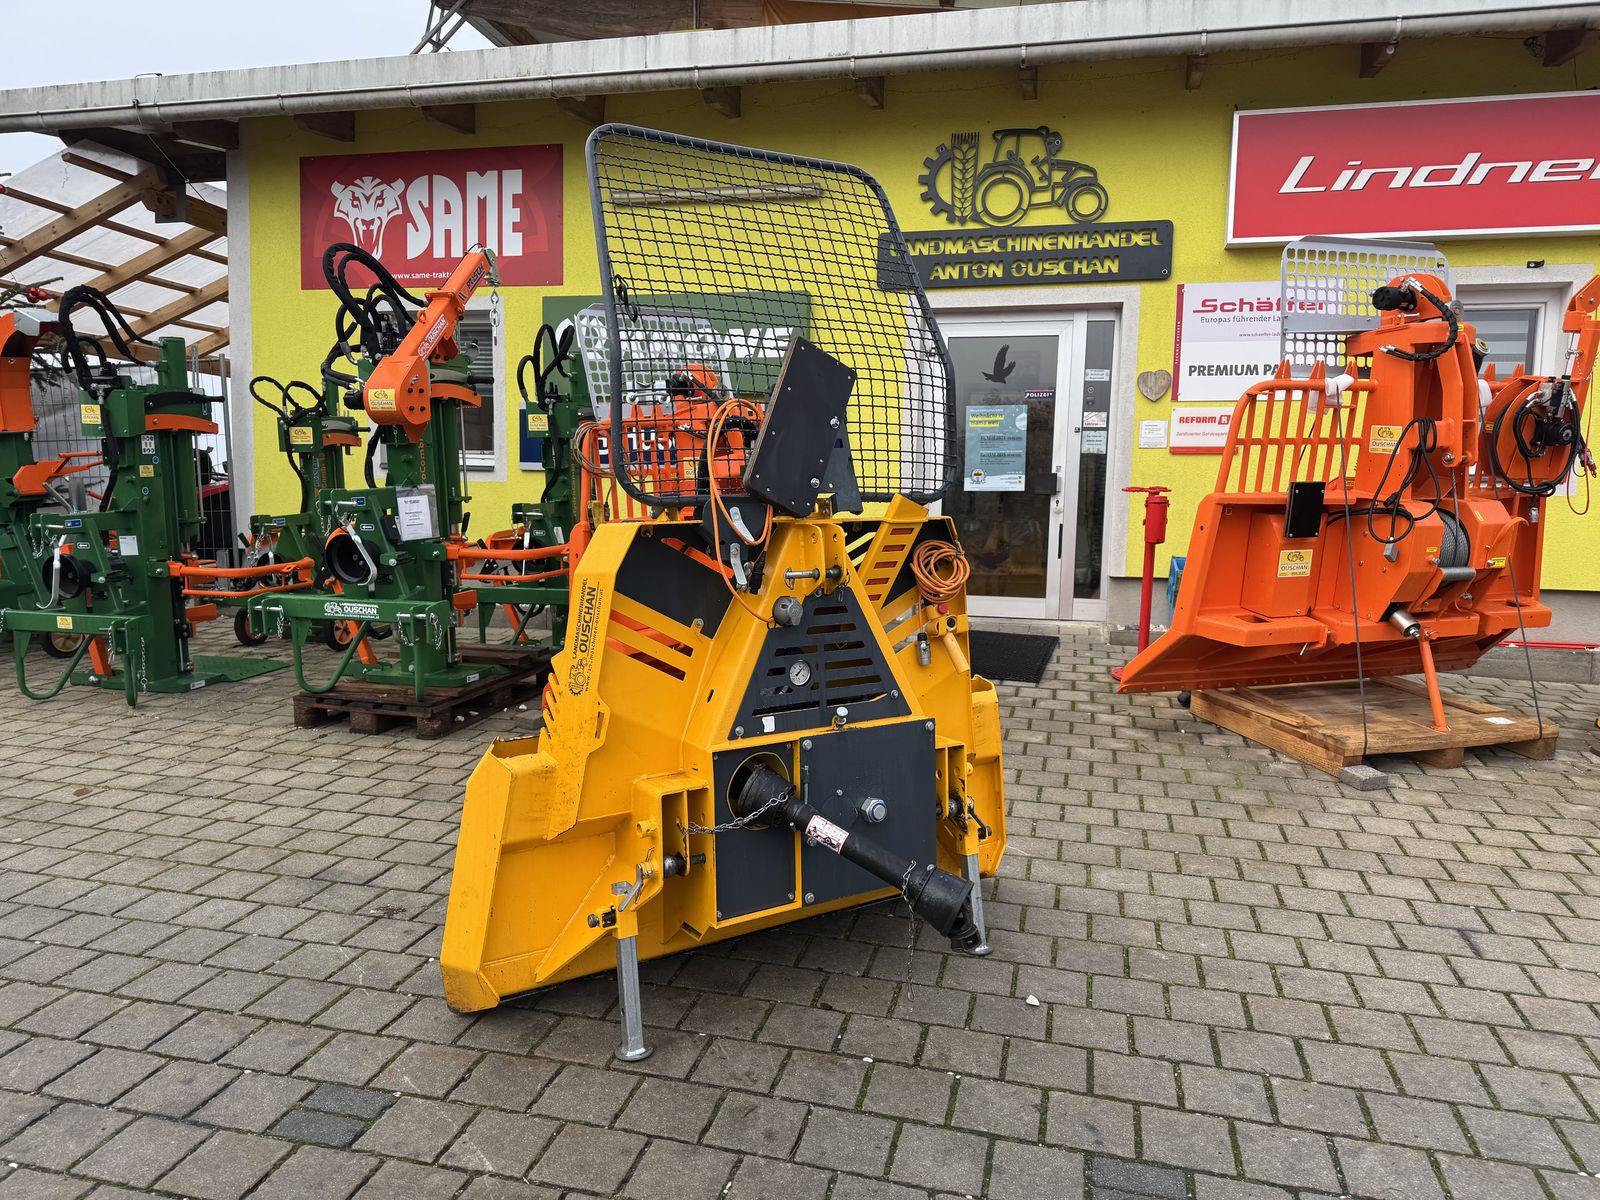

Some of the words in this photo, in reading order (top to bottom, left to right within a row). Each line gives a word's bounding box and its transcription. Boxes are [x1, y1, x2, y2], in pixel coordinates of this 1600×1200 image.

[406, 169, 523, 260] SAME
[929, 260, 1004, 281] ANTON
[1010, 255, 1120, 277] OUSCHAN
[1200, 316, 1231, 324] Europas
[1232, 314, 1272, 323] führender
[1188, 364, 1259, 377] PREMIUM
[1179, 416, 1217, 424] REFORM
[343, 606, 377, 614] OUSCHAN
[579, 586, 597, 653] OUSCHAN
